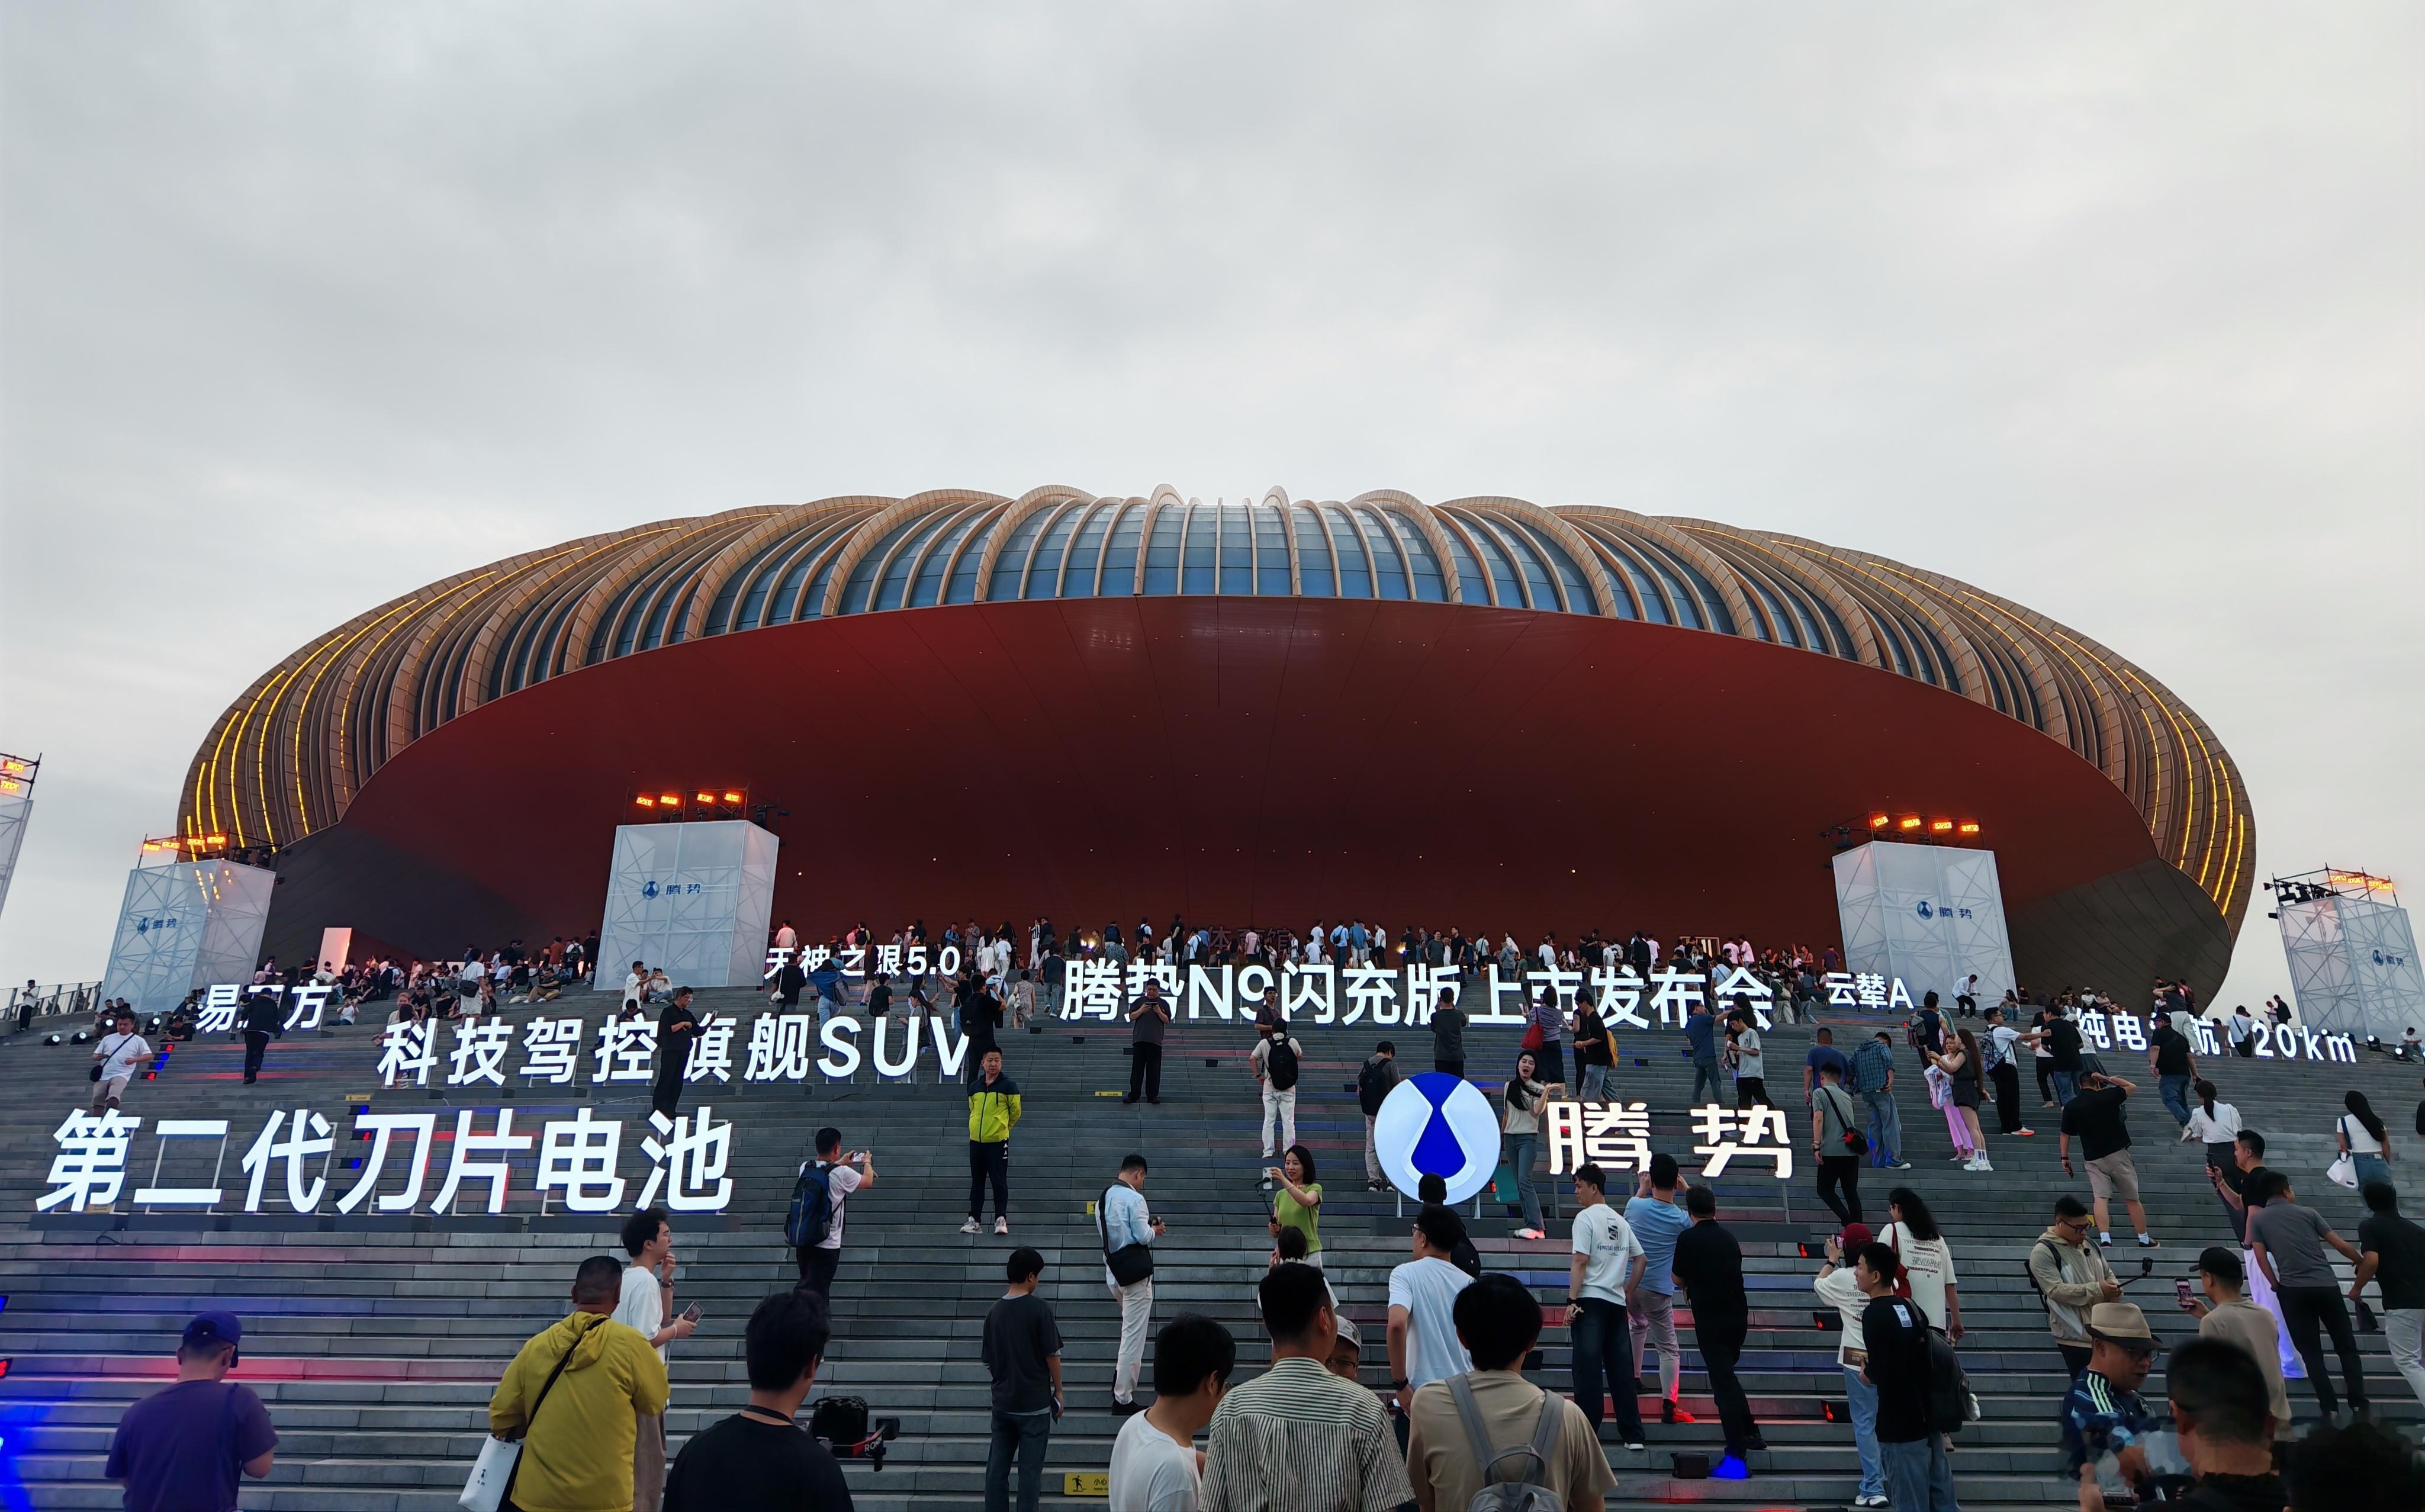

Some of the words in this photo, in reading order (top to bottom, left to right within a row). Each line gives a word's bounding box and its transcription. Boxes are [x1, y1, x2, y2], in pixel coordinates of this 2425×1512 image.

[666, 883, 701, 895] 腾势
[377, 1012, 970, 1086] 科技驾控旗舰SUV
[36, 1106, 734, 1215] 第二代刀片电池
[1546, 1102, 1793, 1179] 腾势
